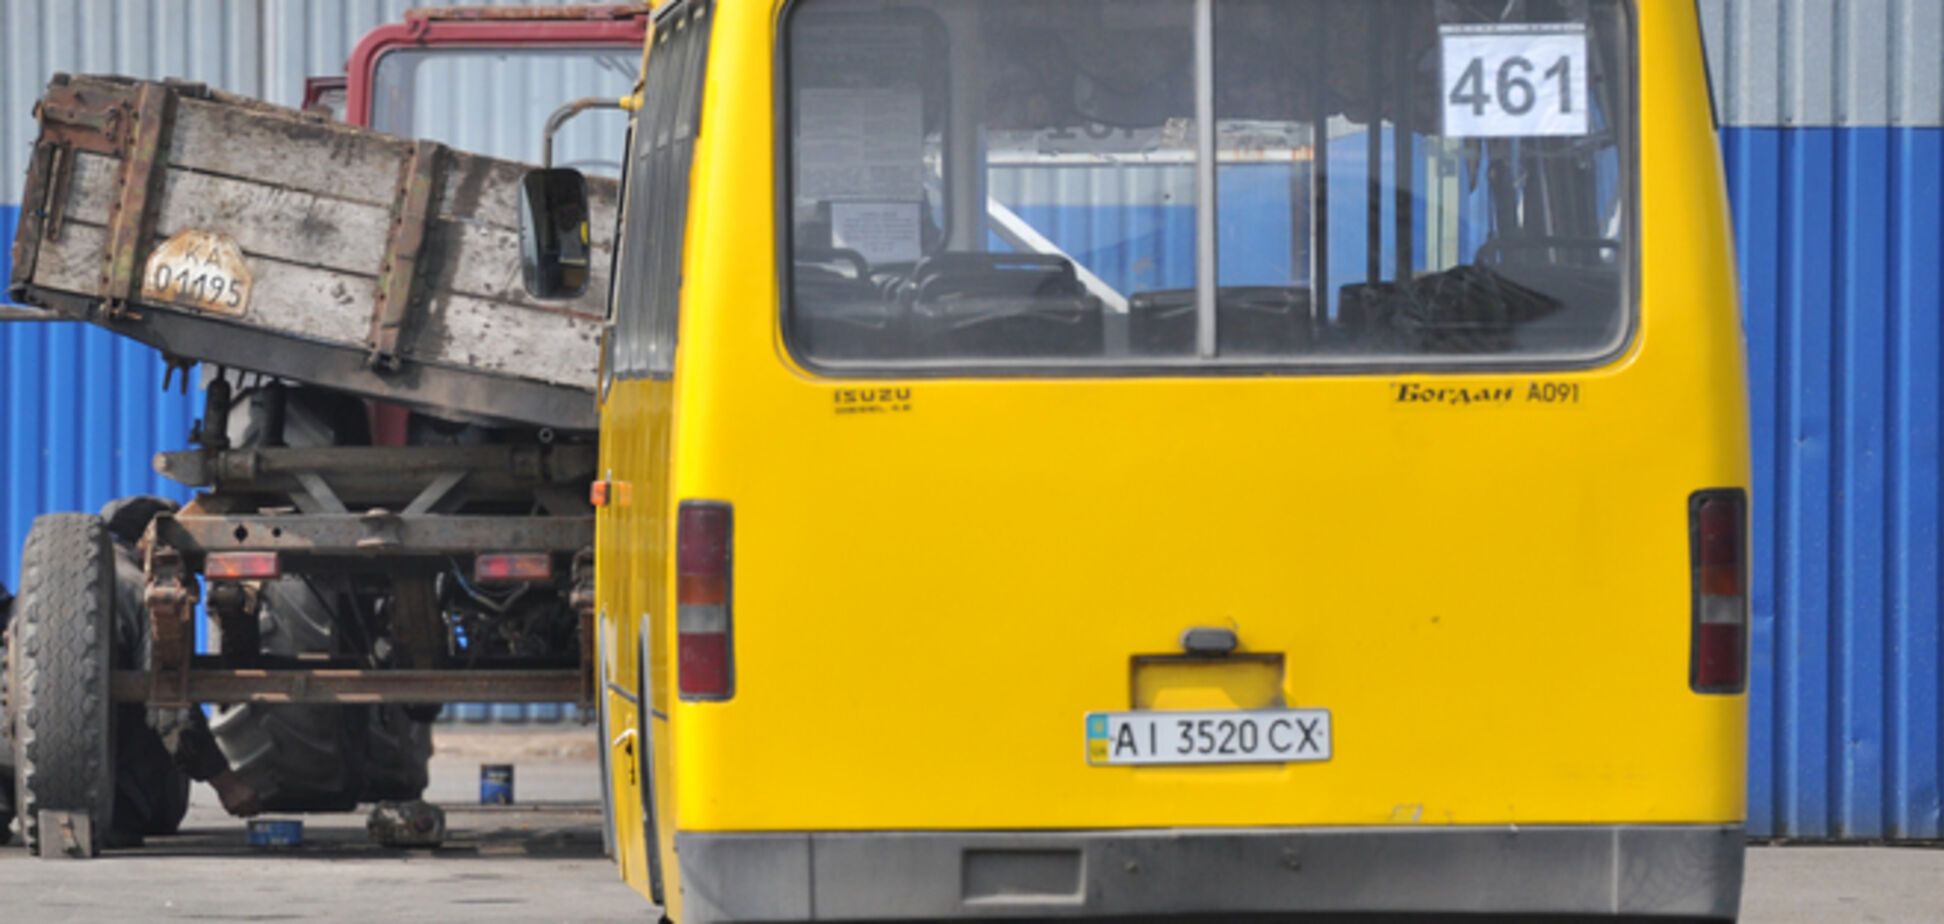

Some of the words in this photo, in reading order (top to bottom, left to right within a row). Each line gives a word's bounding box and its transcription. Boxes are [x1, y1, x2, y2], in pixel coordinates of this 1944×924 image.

[1449, 55, 1571, 117] 461
[155, 263, 241, 308] 01195
[834, 388, 911, 404] ISUZU
[1391, 383, 1514, 406] Богдан
[1526, 381, 1580, 403] A091
[1114, 721, 1157, 756] AI
[1176, 719, 1259, 755] 3520
[1268, 718, 1321, 754] CX
